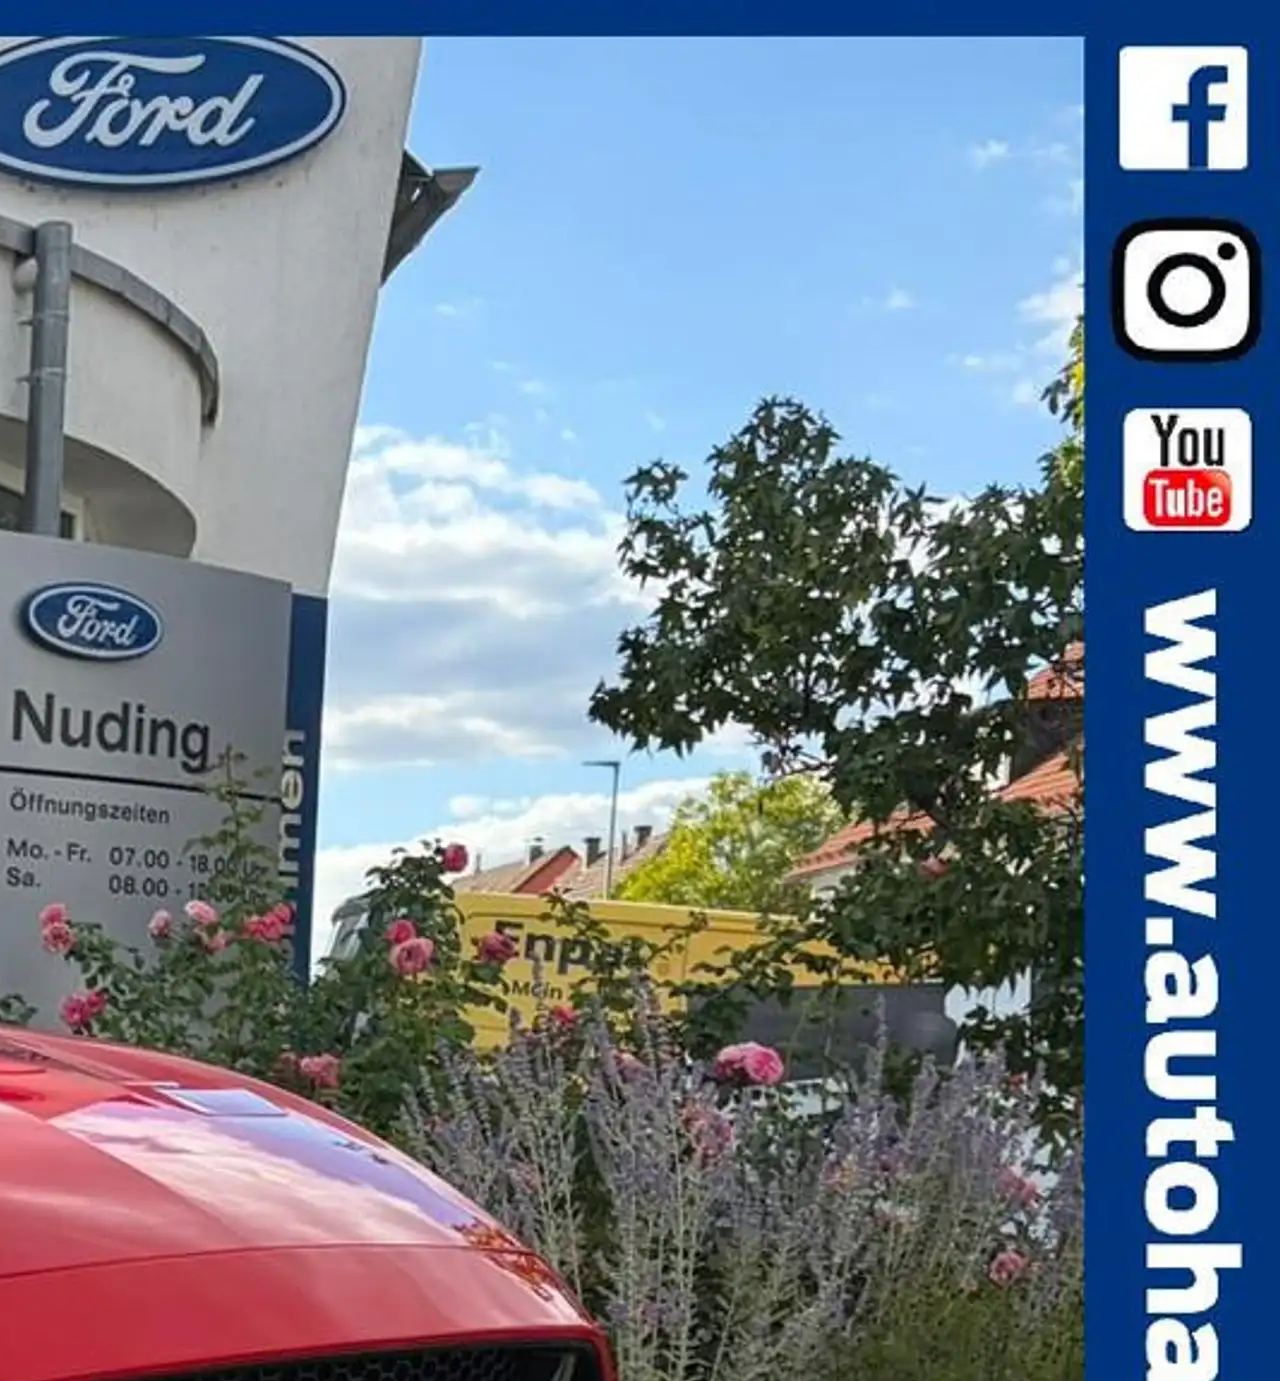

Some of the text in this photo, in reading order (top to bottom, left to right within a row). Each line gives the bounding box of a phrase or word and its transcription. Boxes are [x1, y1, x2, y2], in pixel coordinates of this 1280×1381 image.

[23, 51, 265, 148] Ford
[56, 595, 139, 646] Ford
[11, 688, 211, 774] Nuding
[9, 786, 171, 824] Öffnungszeiten
[6, 837, 49, 860] Mo.
[66, 841, 92, 863] Fr.
[109, 846, 170, 870] 07.00
[6, 866, 41, 889] Sa.
[108, 873, 169, 897] 08.00
